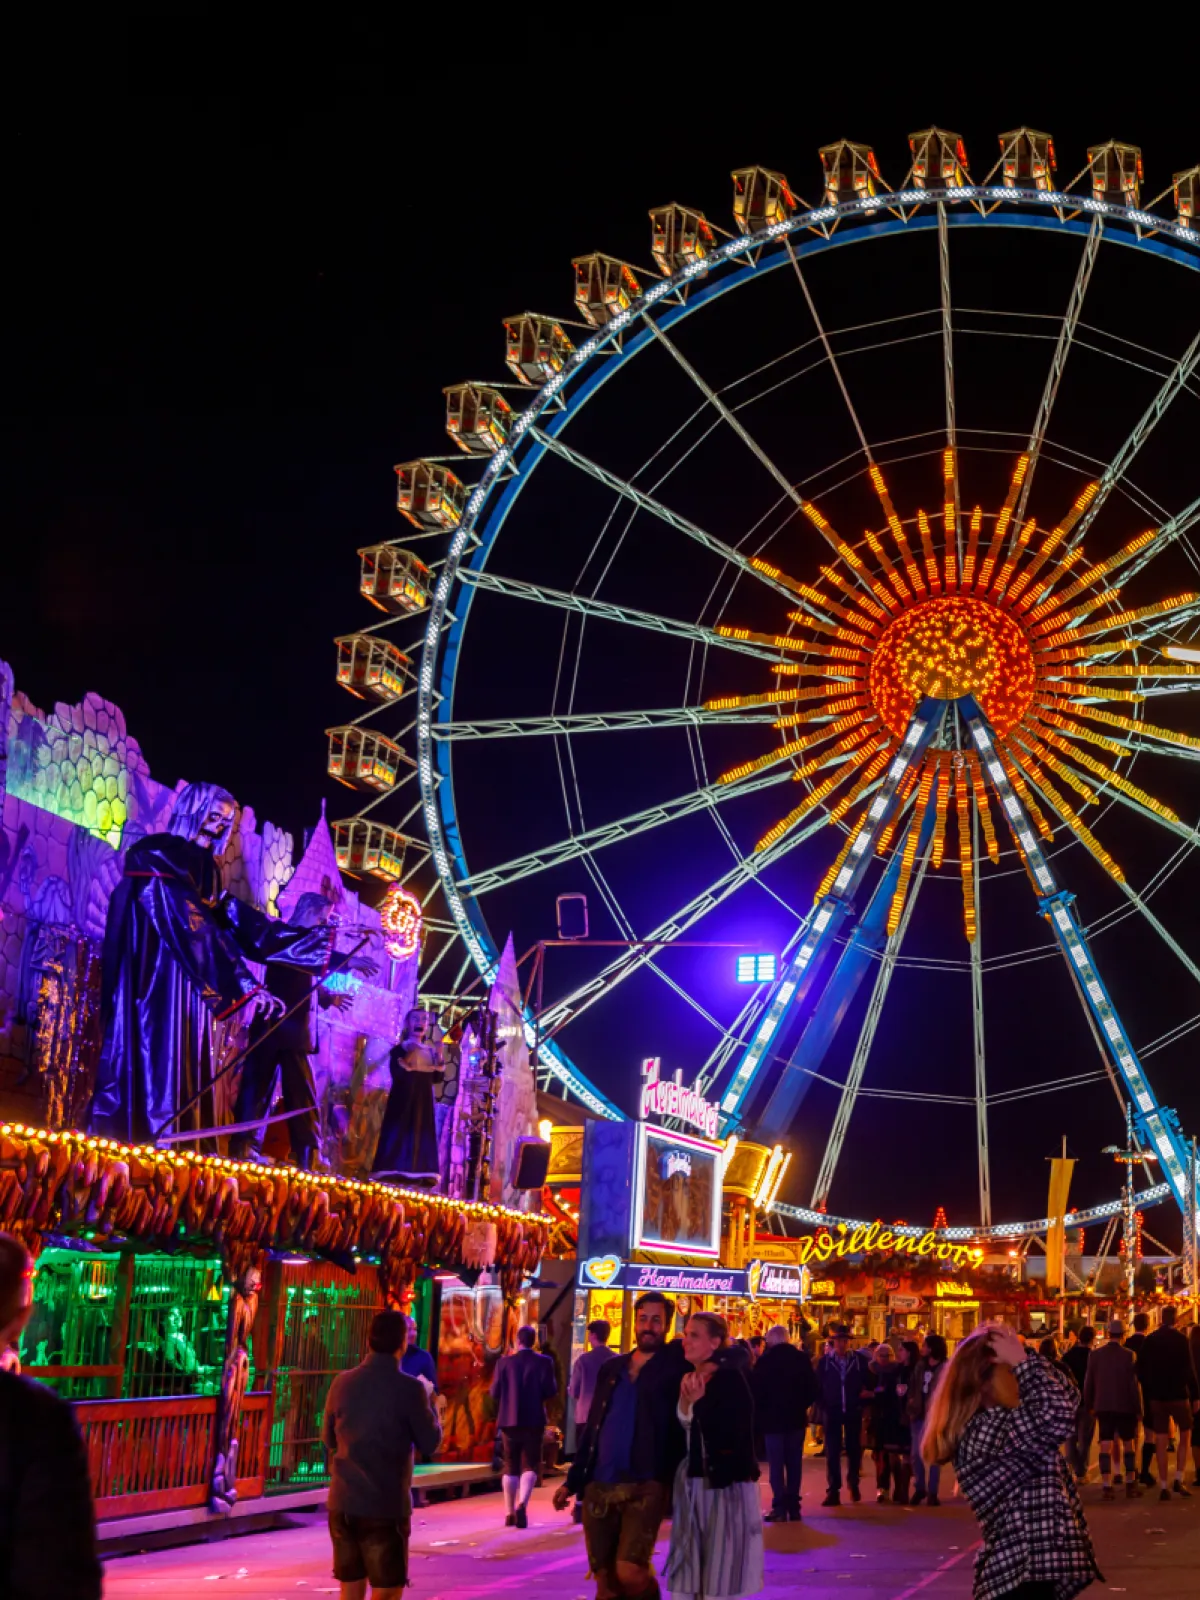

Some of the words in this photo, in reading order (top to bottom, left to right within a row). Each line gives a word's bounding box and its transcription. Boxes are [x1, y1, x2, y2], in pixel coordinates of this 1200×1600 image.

[640, 1057, 720, 1139] Herzlmalerei
[799, 1221, 985, 1269] Willenborg
[638, 1266, 734, 1292] Herzlmalerei
